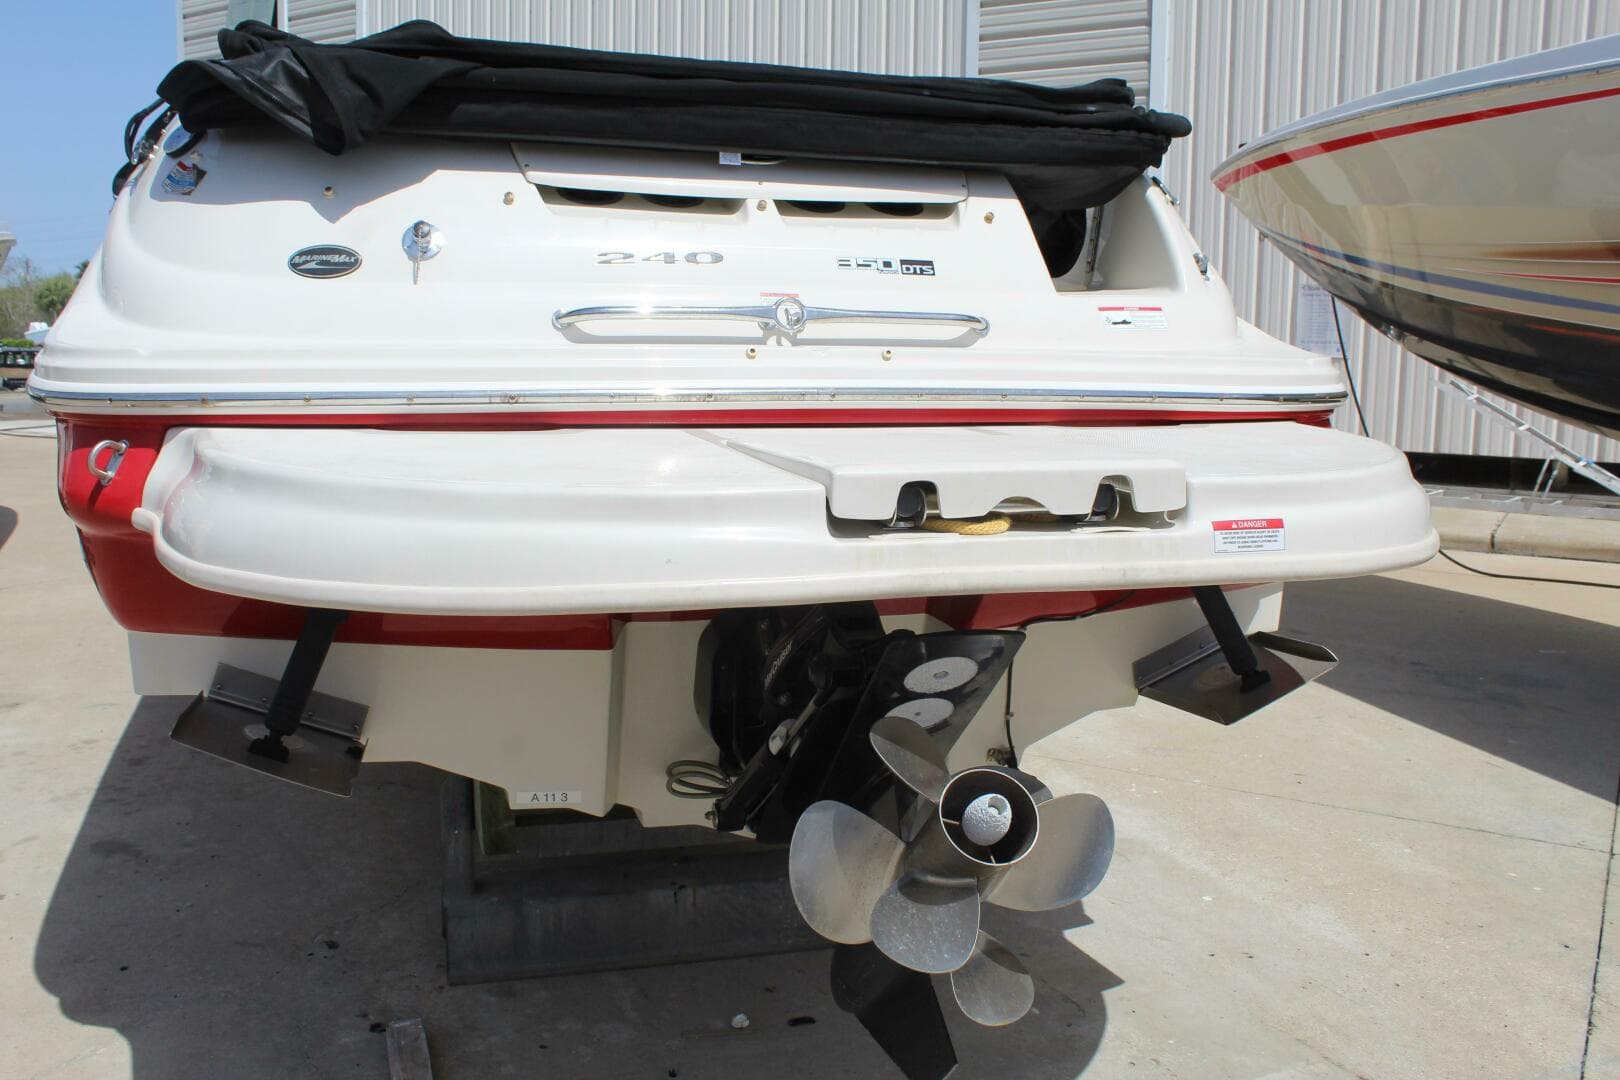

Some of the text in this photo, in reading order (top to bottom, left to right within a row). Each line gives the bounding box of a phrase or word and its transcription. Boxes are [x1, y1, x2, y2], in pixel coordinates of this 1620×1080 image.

[597, 252, 724, 264] 240
[837, 257, 934, 275] 350 DTS
[1238, 520, 1267, 528] DANGER
